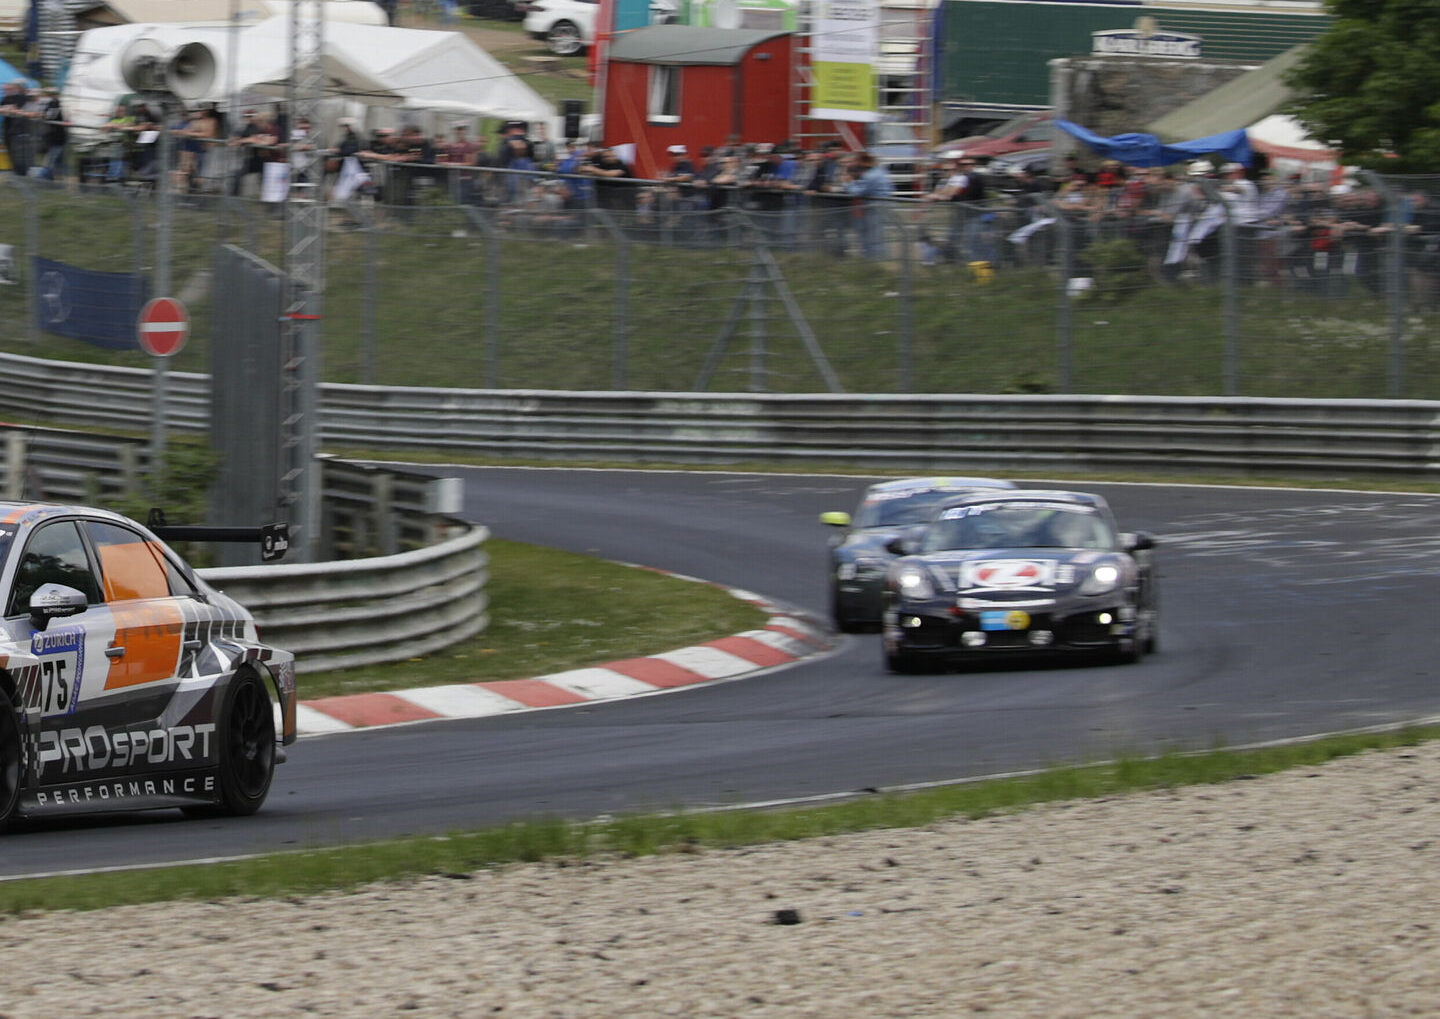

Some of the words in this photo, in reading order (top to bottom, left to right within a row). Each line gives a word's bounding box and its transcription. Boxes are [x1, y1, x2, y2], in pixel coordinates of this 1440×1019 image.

[45, 632, 76, 649] ZURICH
[42, 660, 68, 712] 75
[37, 777, 215, 806] PERFORMANCE
